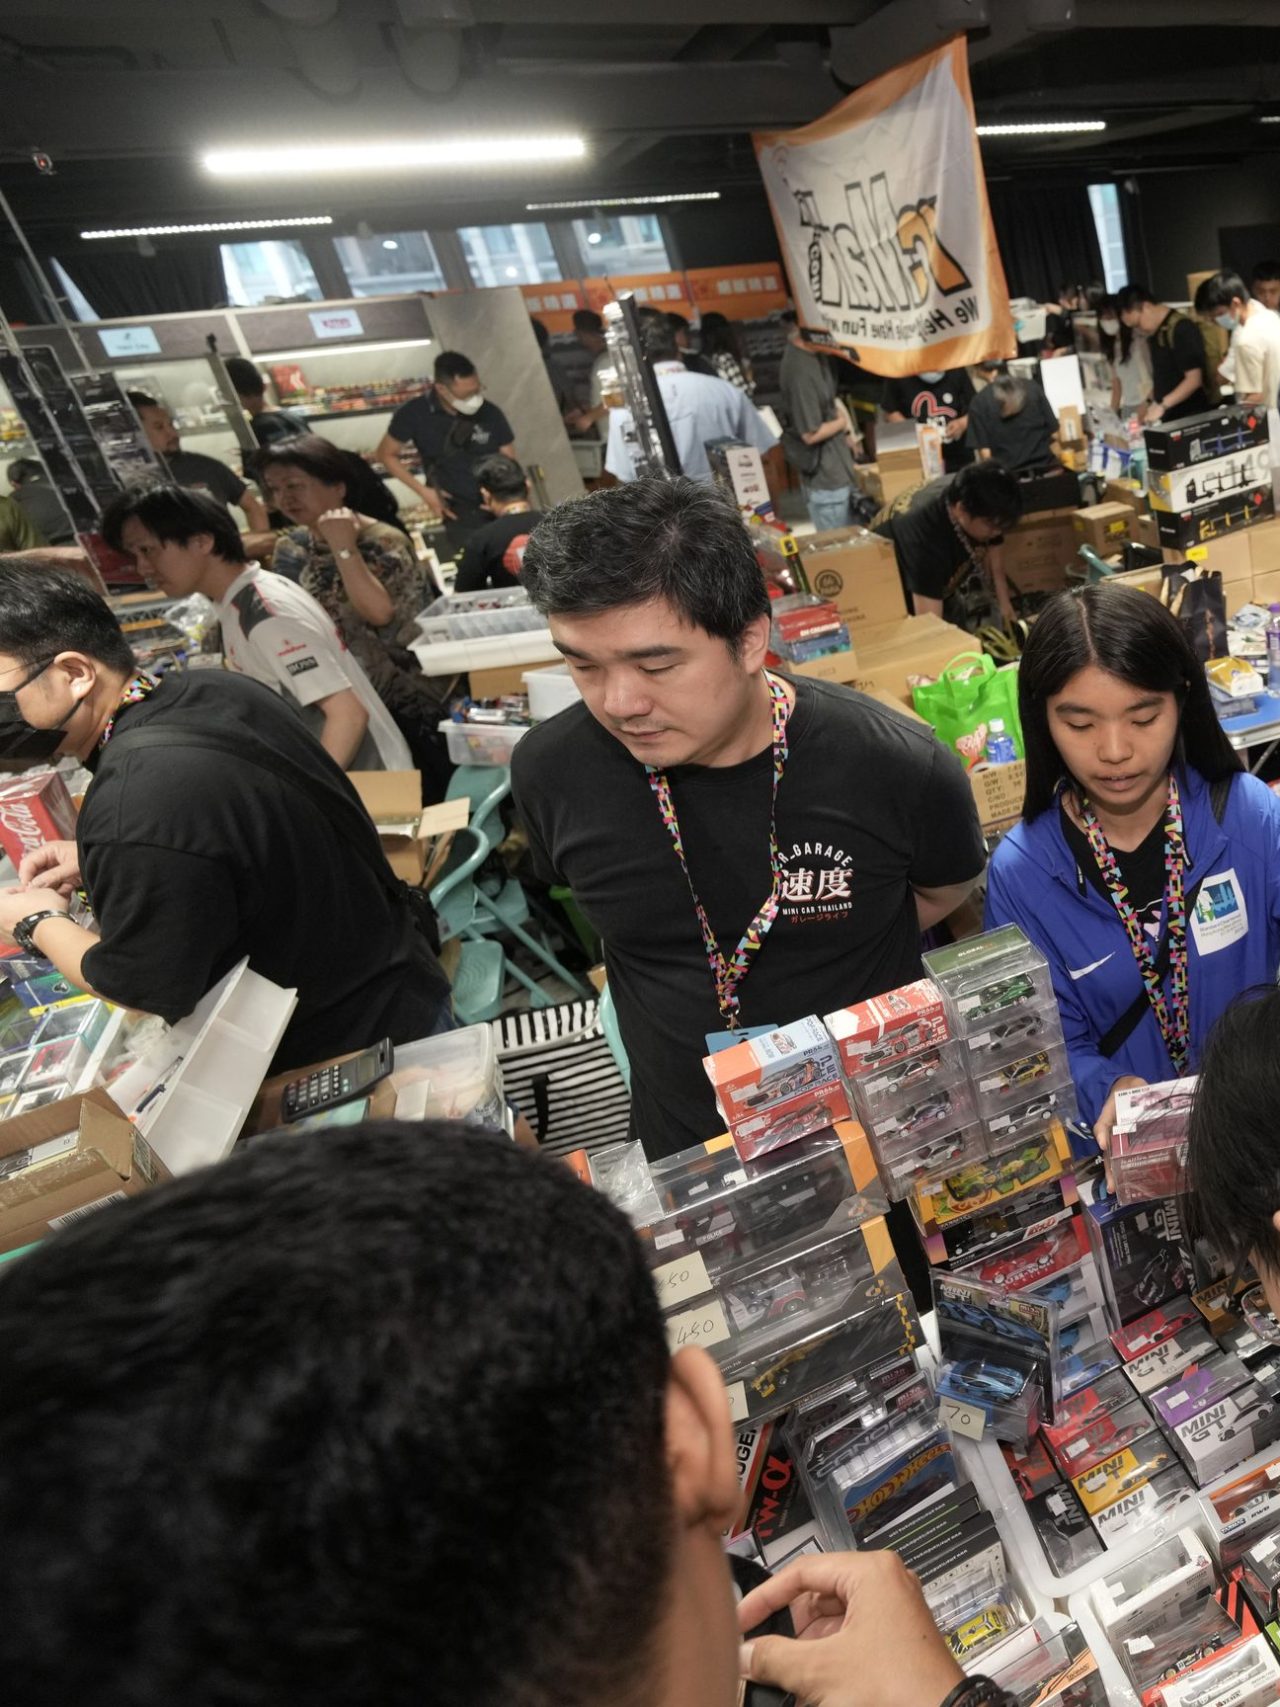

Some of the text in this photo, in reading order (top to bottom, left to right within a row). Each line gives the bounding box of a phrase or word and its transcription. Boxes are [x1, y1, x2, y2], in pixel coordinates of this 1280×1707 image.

[776, 841, 853, 868] R-GARAGE
[780, 866, 854, 903] 速度
[782, 901, 853, 916] MINI CAR THAILAND
[702, 1229, 724, 1242] POLICE
[1164, 1199, 1183, 1242] MINI
[939, 1283, 971, 1298] MINI
[1127, 1343, 1170, 1375] MINI
[945, 1404, 972, 1426] 70
[1180, 1402, 1226, 1440] MINI
[1191, 1414, 1227, 1444] GT
[1077, 1453, 1124, 1490] MINI
[1053, 1482, 1085, 1529] MINI
[1098, 1488, 1145, 1529] MINI
